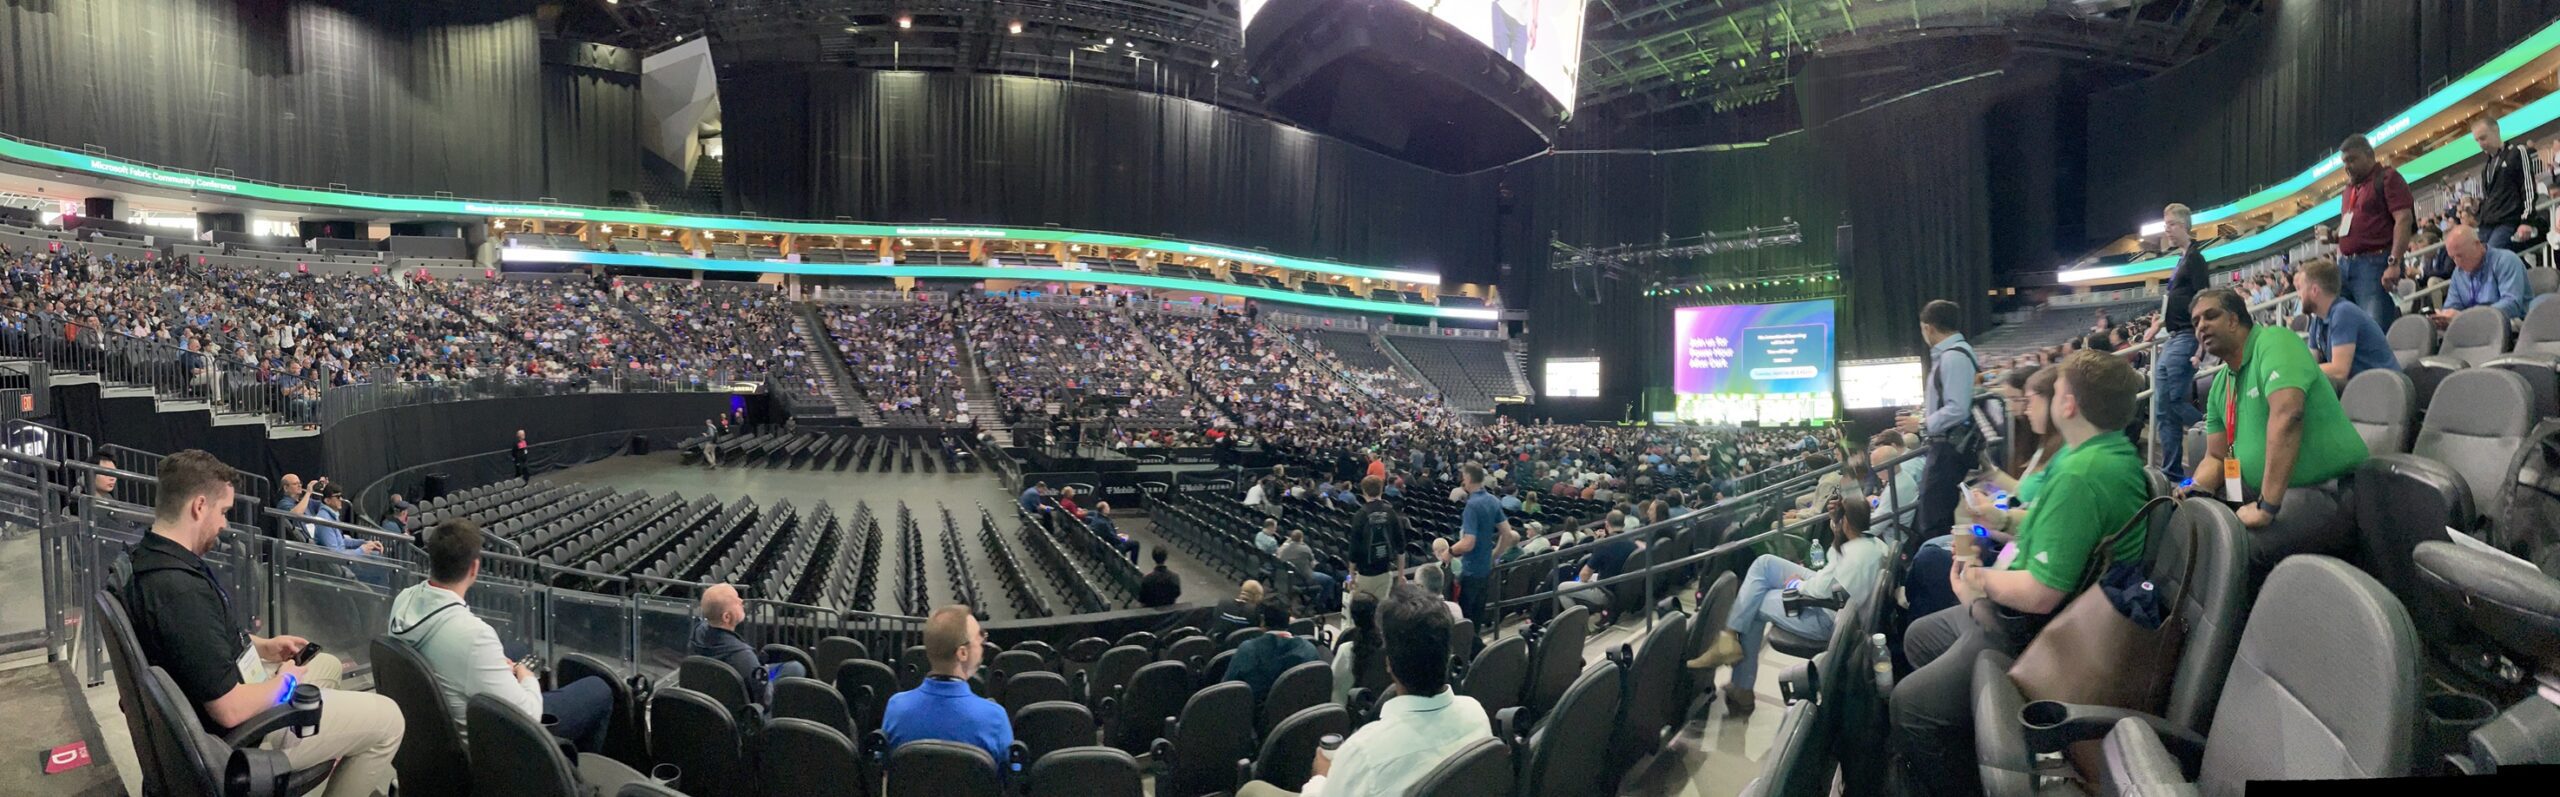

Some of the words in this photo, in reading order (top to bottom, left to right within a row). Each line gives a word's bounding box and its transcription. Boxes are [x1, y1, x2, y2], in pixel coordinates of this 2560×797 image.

[90, 160, 128, 174] Microsoft
[129, 168, 152, 180] Fabric
[152, 171, 196, 188] Community
[196, 177, 237, 191] Conference
